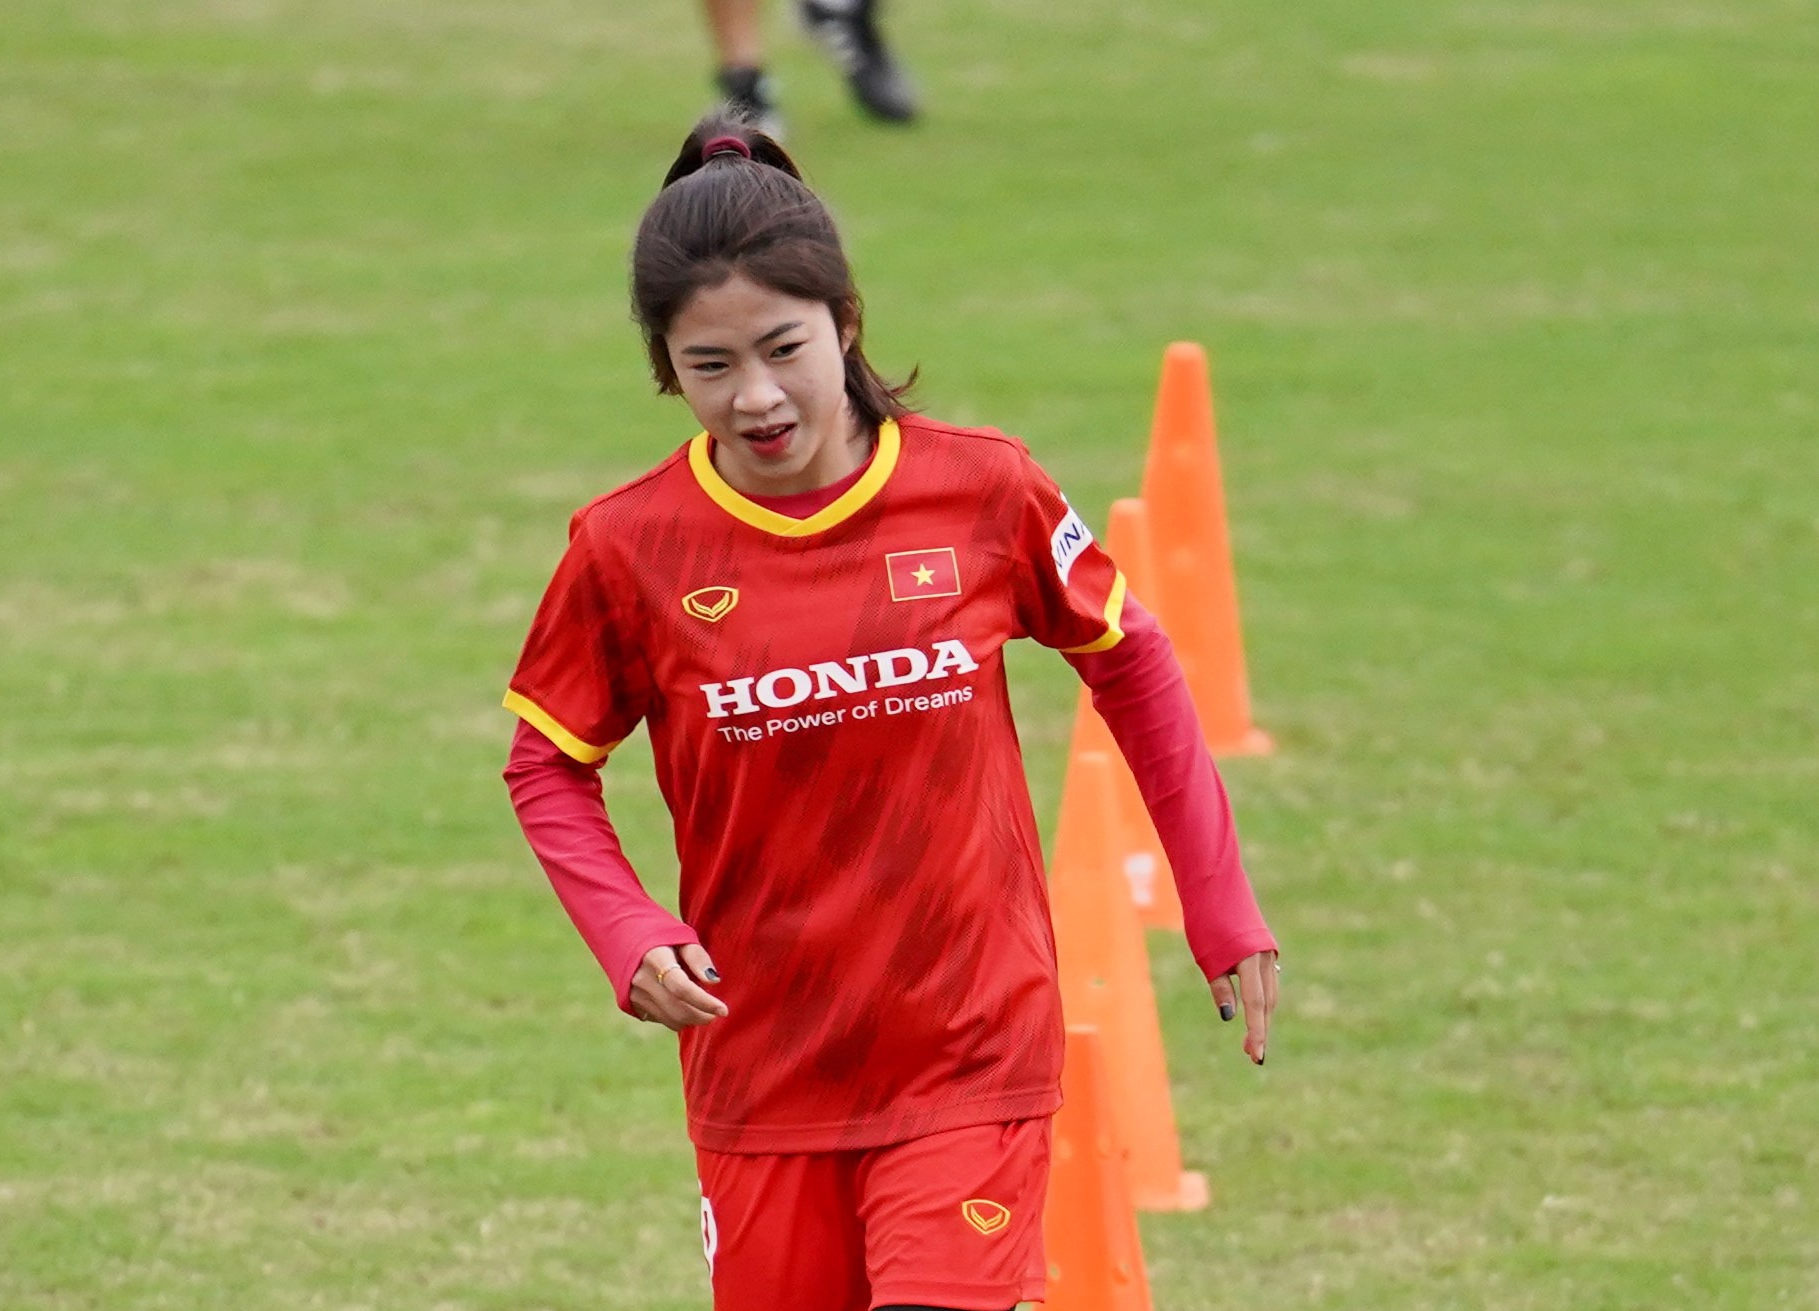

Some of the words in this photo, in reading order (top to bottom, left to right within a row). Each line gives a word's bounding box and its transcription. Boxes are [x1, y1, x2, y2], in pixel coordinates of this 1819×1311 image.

[699, 639, 979, 718] HONDA
[717, 726, 763, 743] The
[766, 709, 847, 737] Power
[852, 701, 879, 720] of
[885, 685, 974, 716] Dreams
